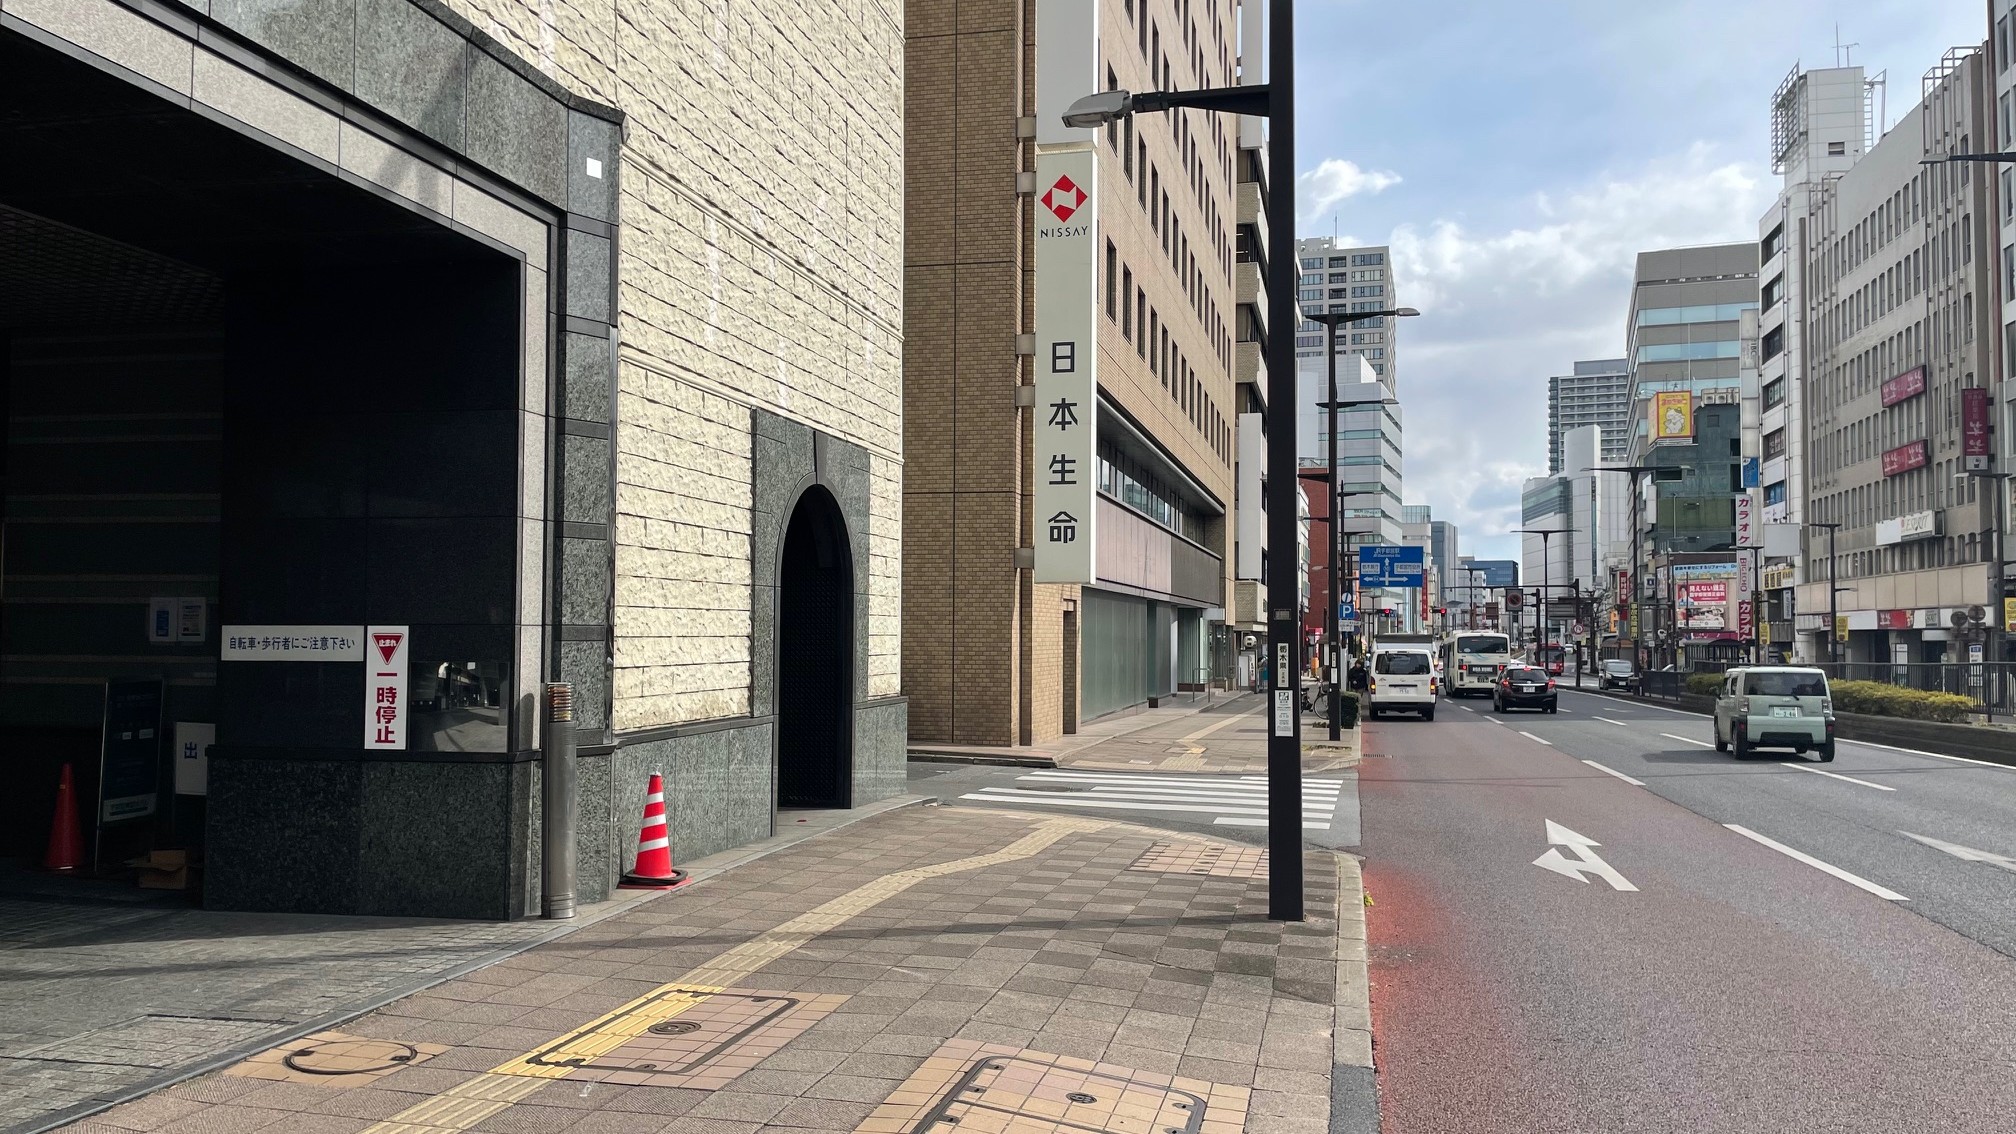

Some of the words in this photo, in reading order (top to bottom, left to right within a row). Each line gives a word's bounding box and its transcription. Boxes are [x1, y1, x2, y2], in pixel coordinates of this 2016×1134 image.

[1040, 225, 1088, 238] NISSAY
[1048, 341, 1078, 544] 日本生命
[1738, 498, 1750, 545] カラオケ
[1343, 606, 1352, 617] P
[1740, 604, 1752, 644] カラオケ
[229, 636, 355, 651] 自転車・歩行者にご注意下さい
[378, 639, 397, 648] 止まれ
[374, 670, 398, 744] 一時停止
